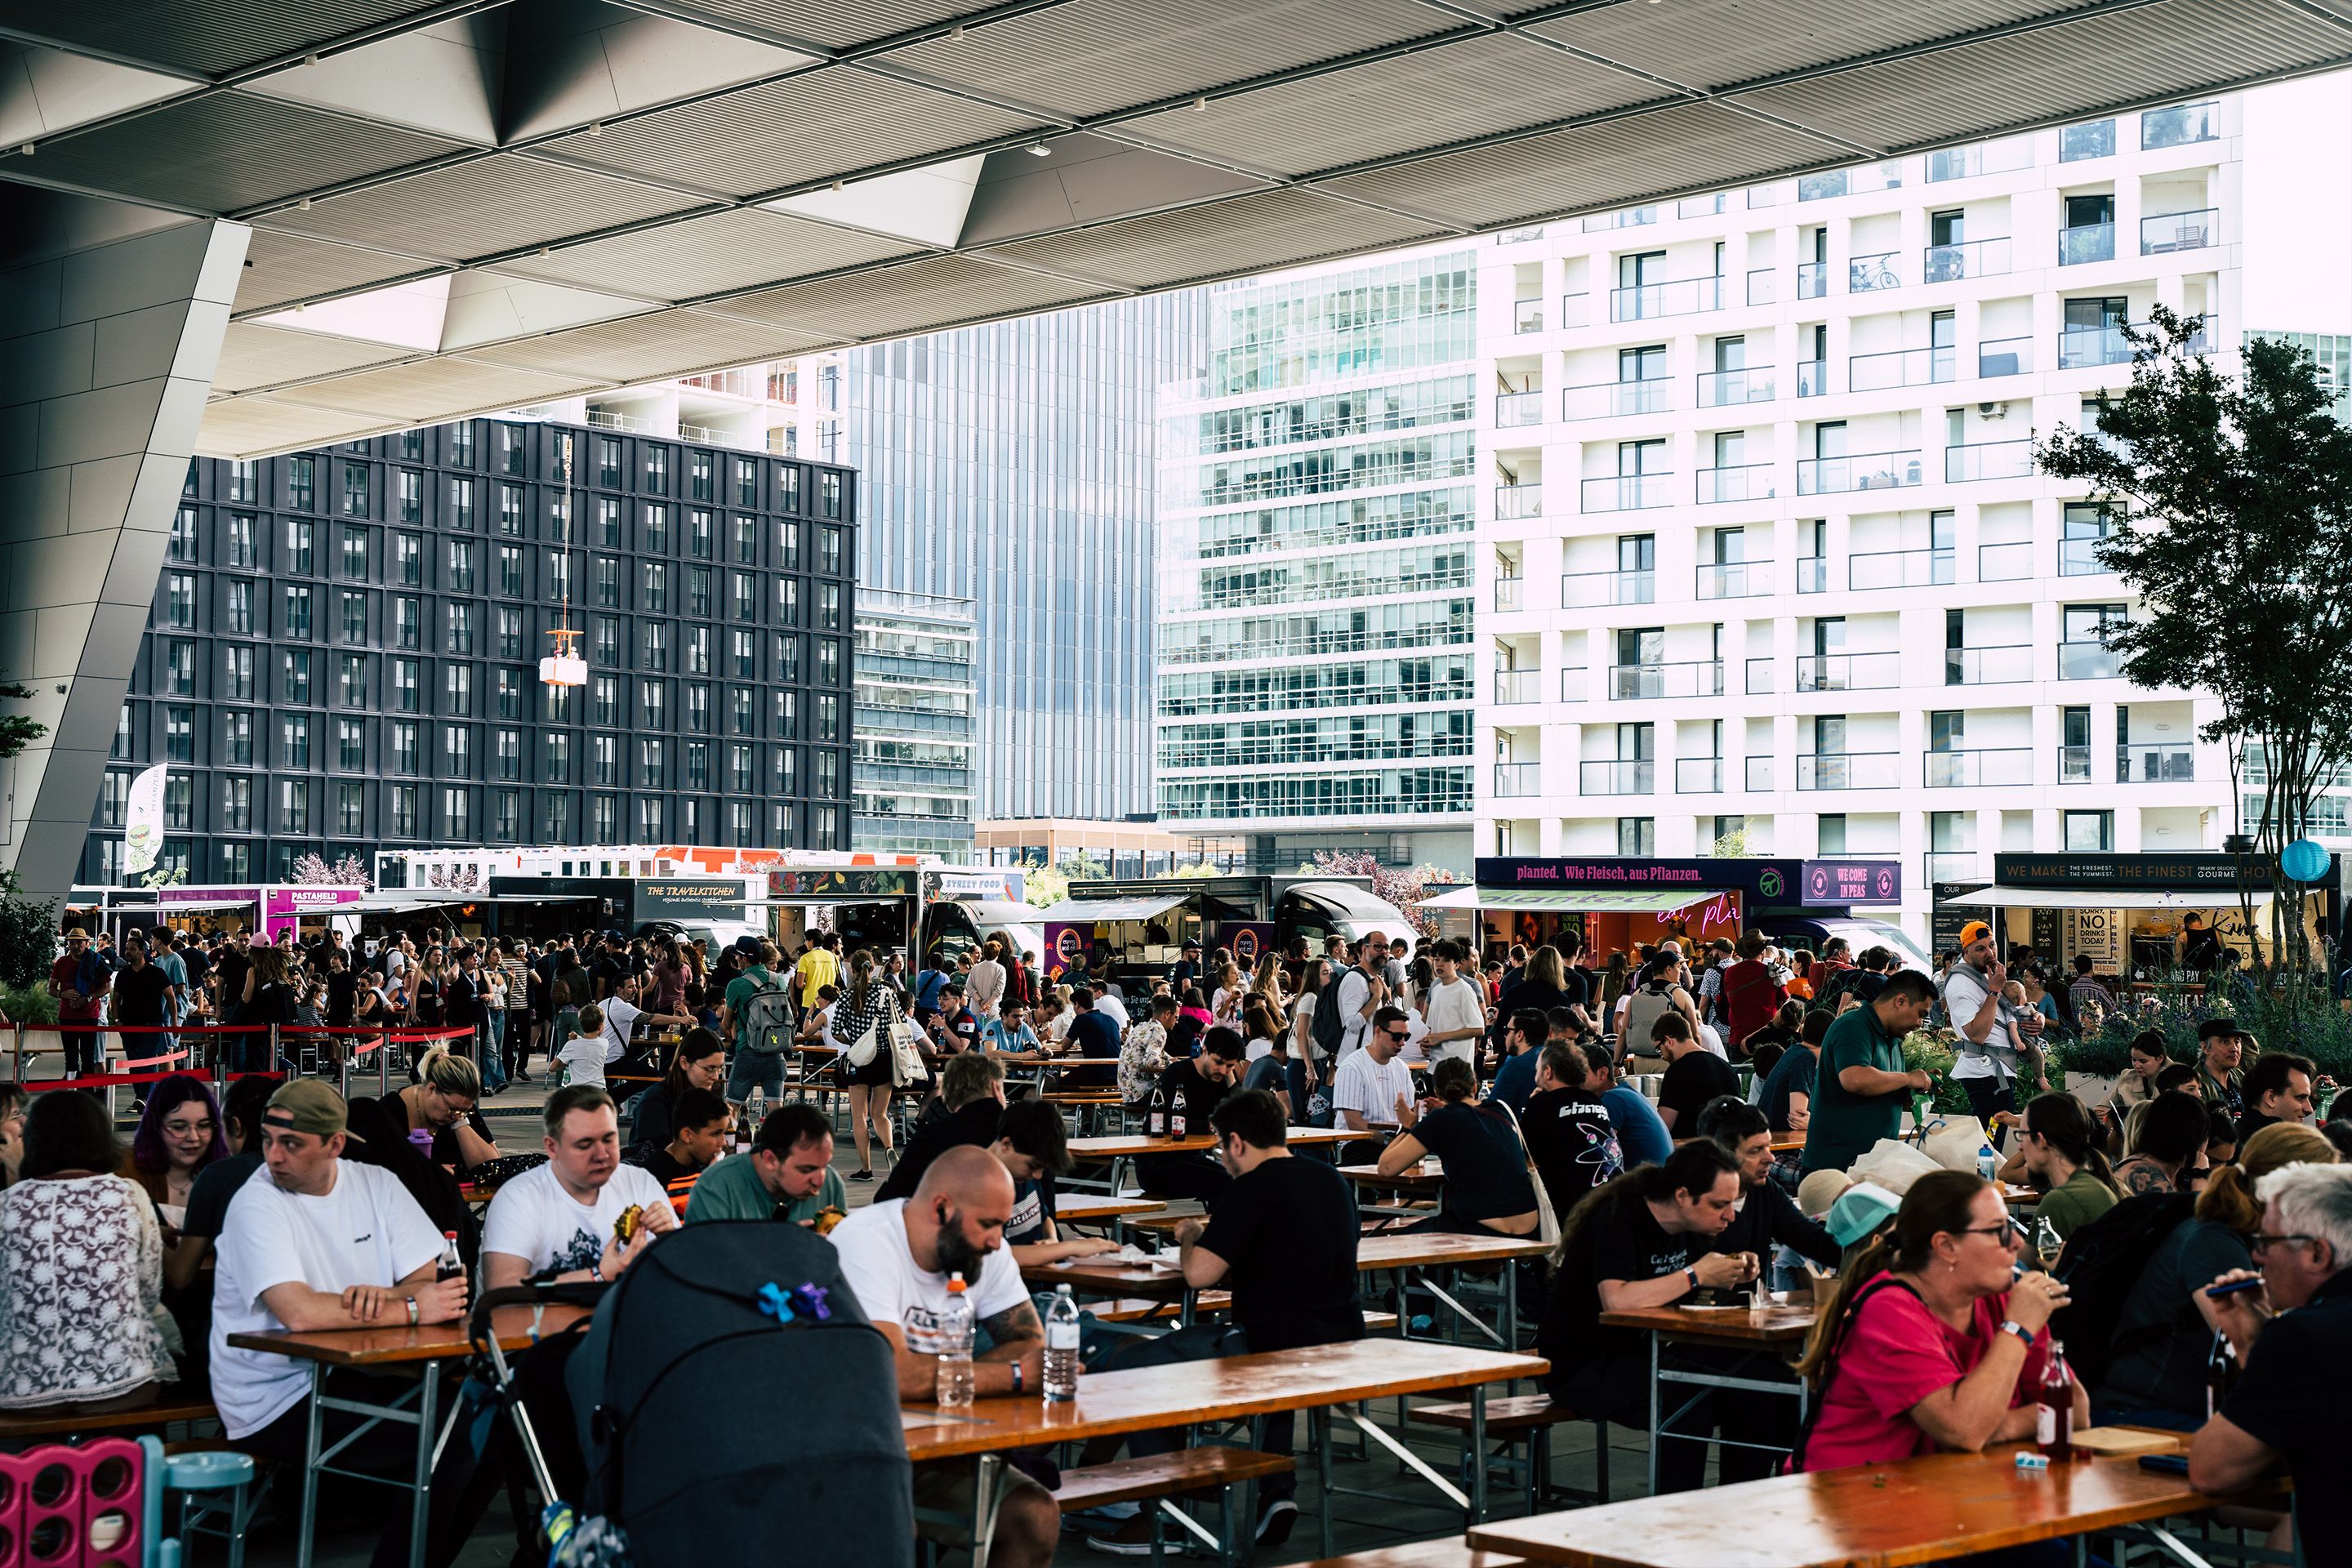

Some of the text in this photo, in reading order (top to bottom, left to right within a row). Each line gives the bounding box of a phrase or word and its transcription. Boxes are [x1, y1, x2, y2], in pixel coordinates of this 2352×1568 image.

[1517, 865, 1702, 881] planted. Wie Fleisch, aus Pflanzen.
[1837, 868, 1868, 881] WE COME
[2006, 865, 2065, 876] WE MAKE
[2118, 866, 2194, 877] THE FINEST
[2243, 866, 2273, 879] HOT
[946, 880, 1000, 889] STREET FOOD
[291, 892, 338, 900] PASTAHELD
[647, 887, 736, 896] THE TRAVELKITCHEN
[1840, 884, 1865, 898] IN PEAS
[2080, 915, 2105, 929] NO
[2186, 970, 2199, 982] PAY
